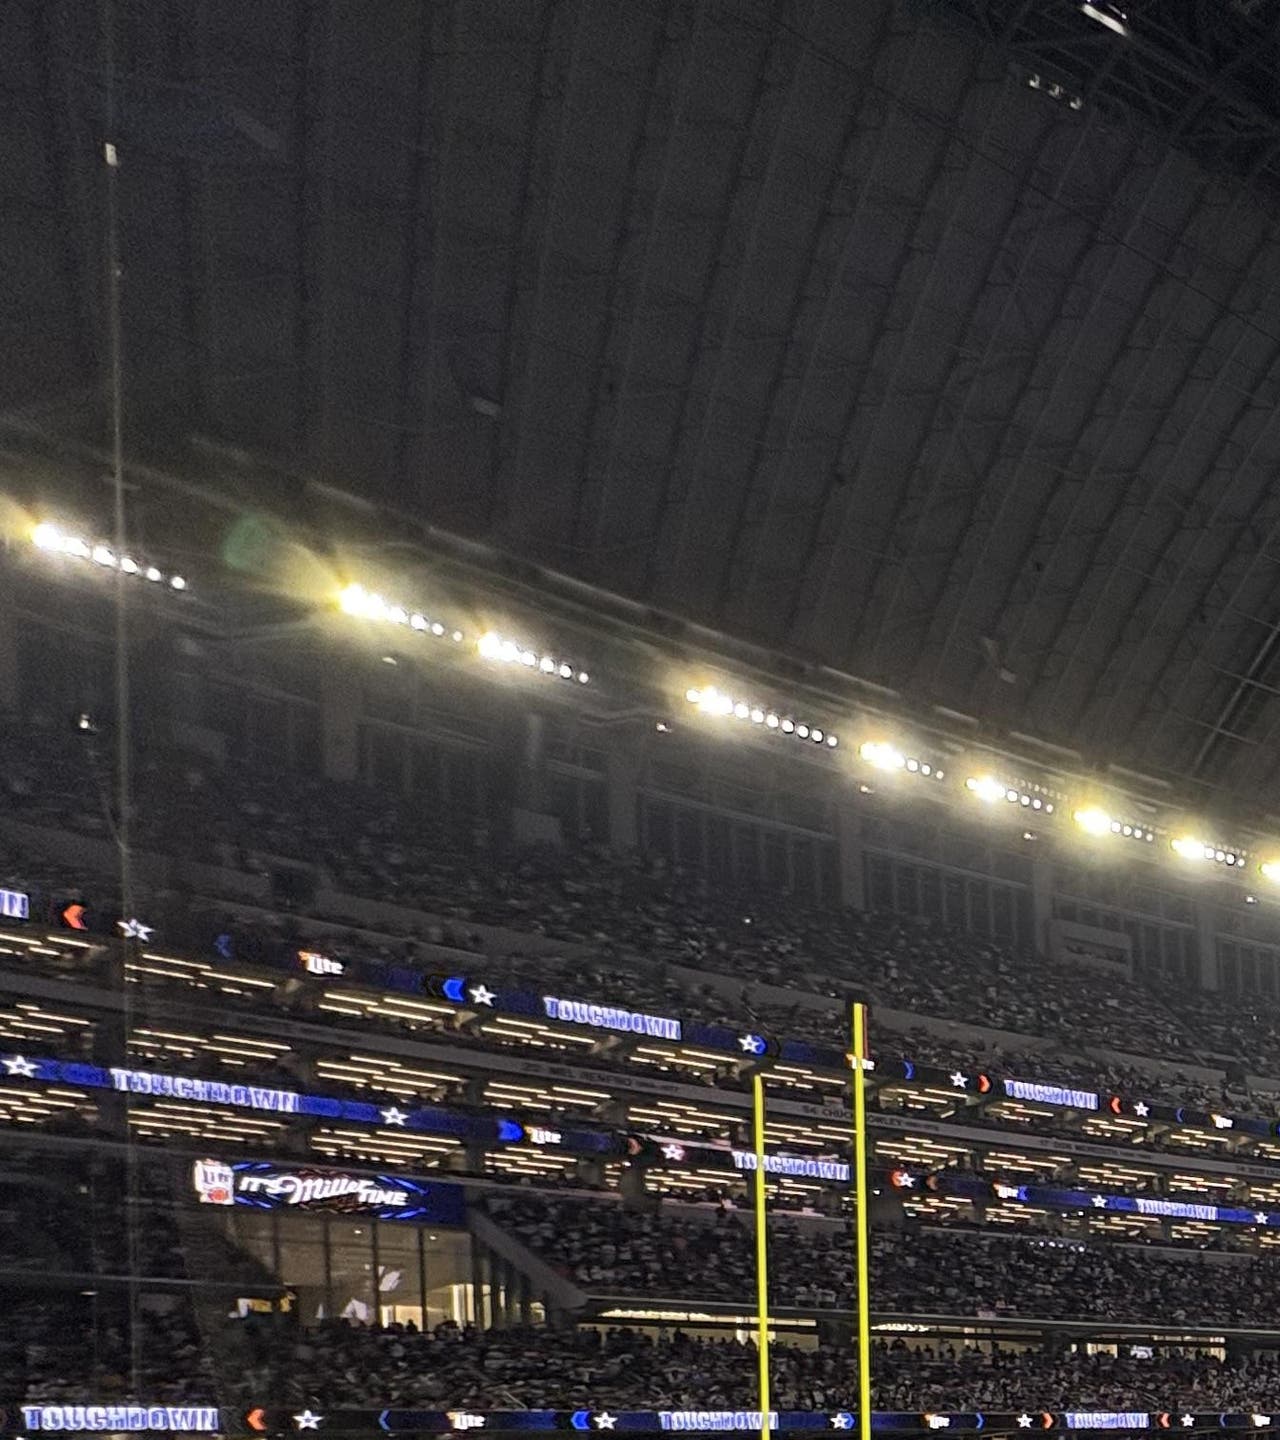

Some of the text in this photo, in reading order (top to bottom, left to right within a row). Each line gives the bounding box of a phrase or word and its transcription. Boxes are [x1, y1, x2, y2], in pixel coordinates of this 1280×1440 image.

[543, 996, 682, 1041] TOUCHDOWN
[111, 1068, 299, 1113] TOUCHDOWN
[239, 1176, 279, 1195] IT'S
[277, 1175, 375, 1204] Miller
[22, 1405, 219, 1432] TOUCHDOWN
